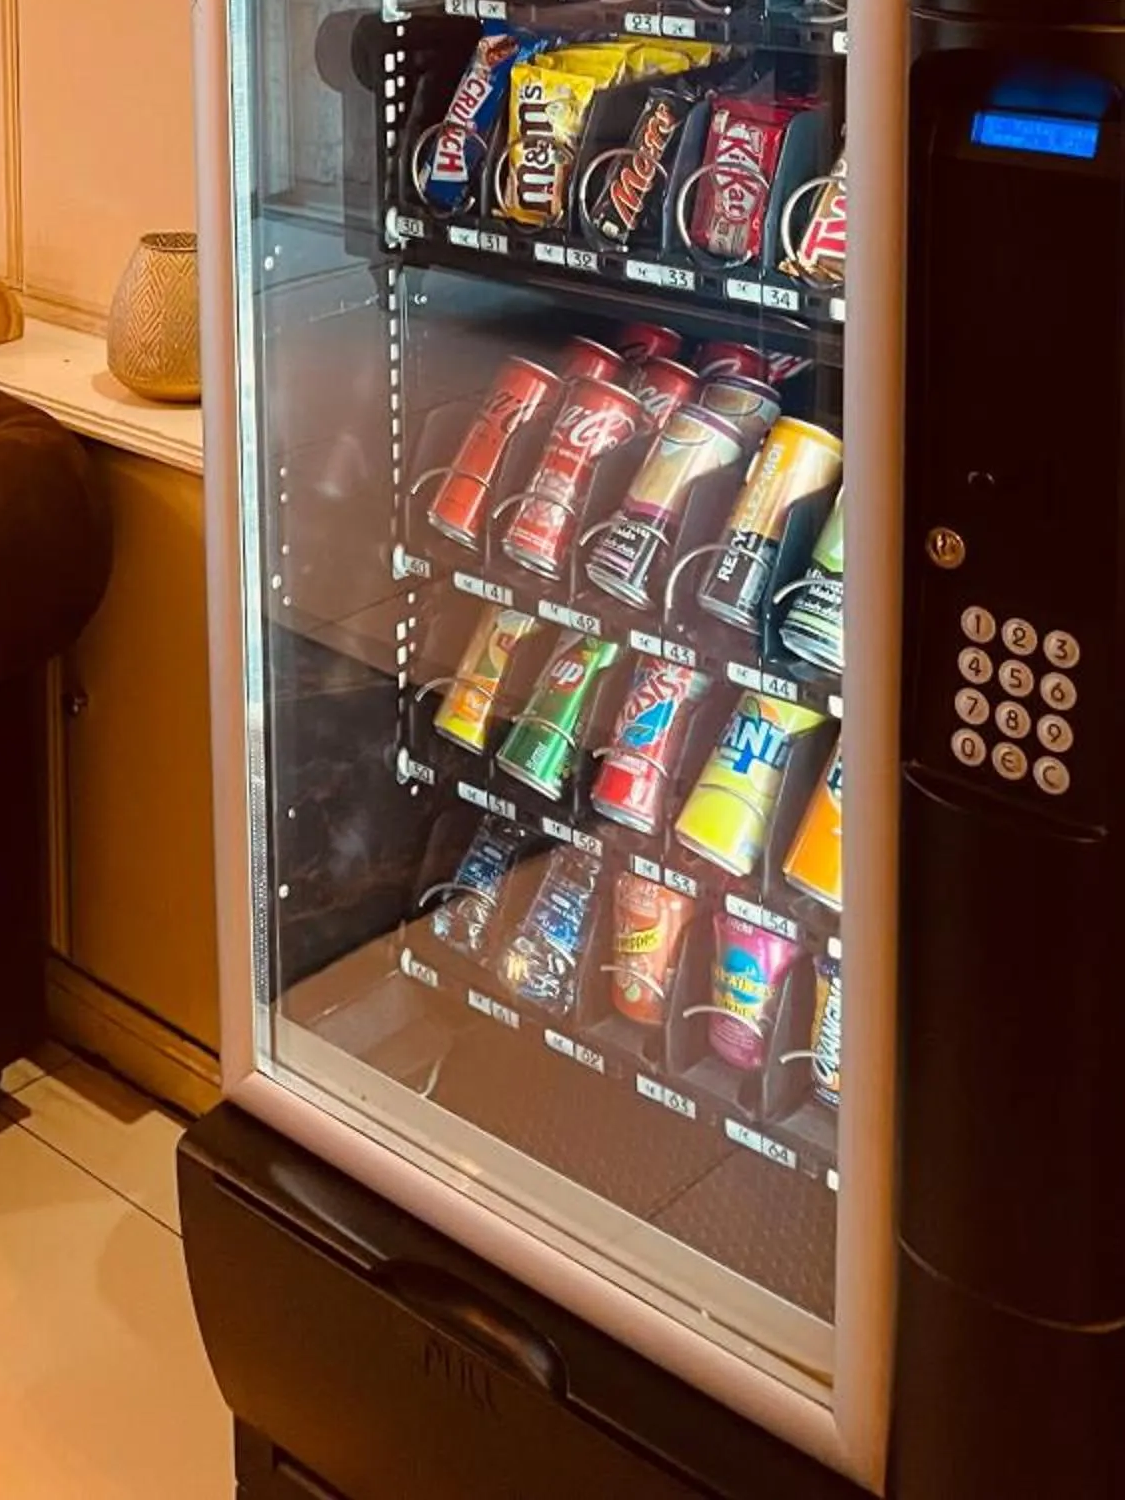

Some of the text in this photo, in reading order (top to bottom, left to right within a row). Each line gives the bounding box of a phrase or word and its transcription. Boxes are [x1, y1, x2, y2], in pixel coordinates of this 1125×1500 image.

[632, 15, 652, 32] 23
[486, 234, 502, 250] 31
[573, 251, 593, 269] 32
[668, 269, 689, 287] 33
[770, 289, 790, 308] 34
[575, 614, 595, 632] 42
[973, 615, 1068, 661] 1 2 3
[669, 645, 690, 664] 43
[768, 677, 790, 696] 44
[968, 657, 1065, 704] 4 5 6
[967, 697, 1062, 745] 7 8 9
[961, 737, 975, 759] 0
[1043, 765, 1059, 787] C
[579, 832, 597, 852] 52
[769, 914, 789, 934] 54
[768, 1143, 790, 1162] 64
